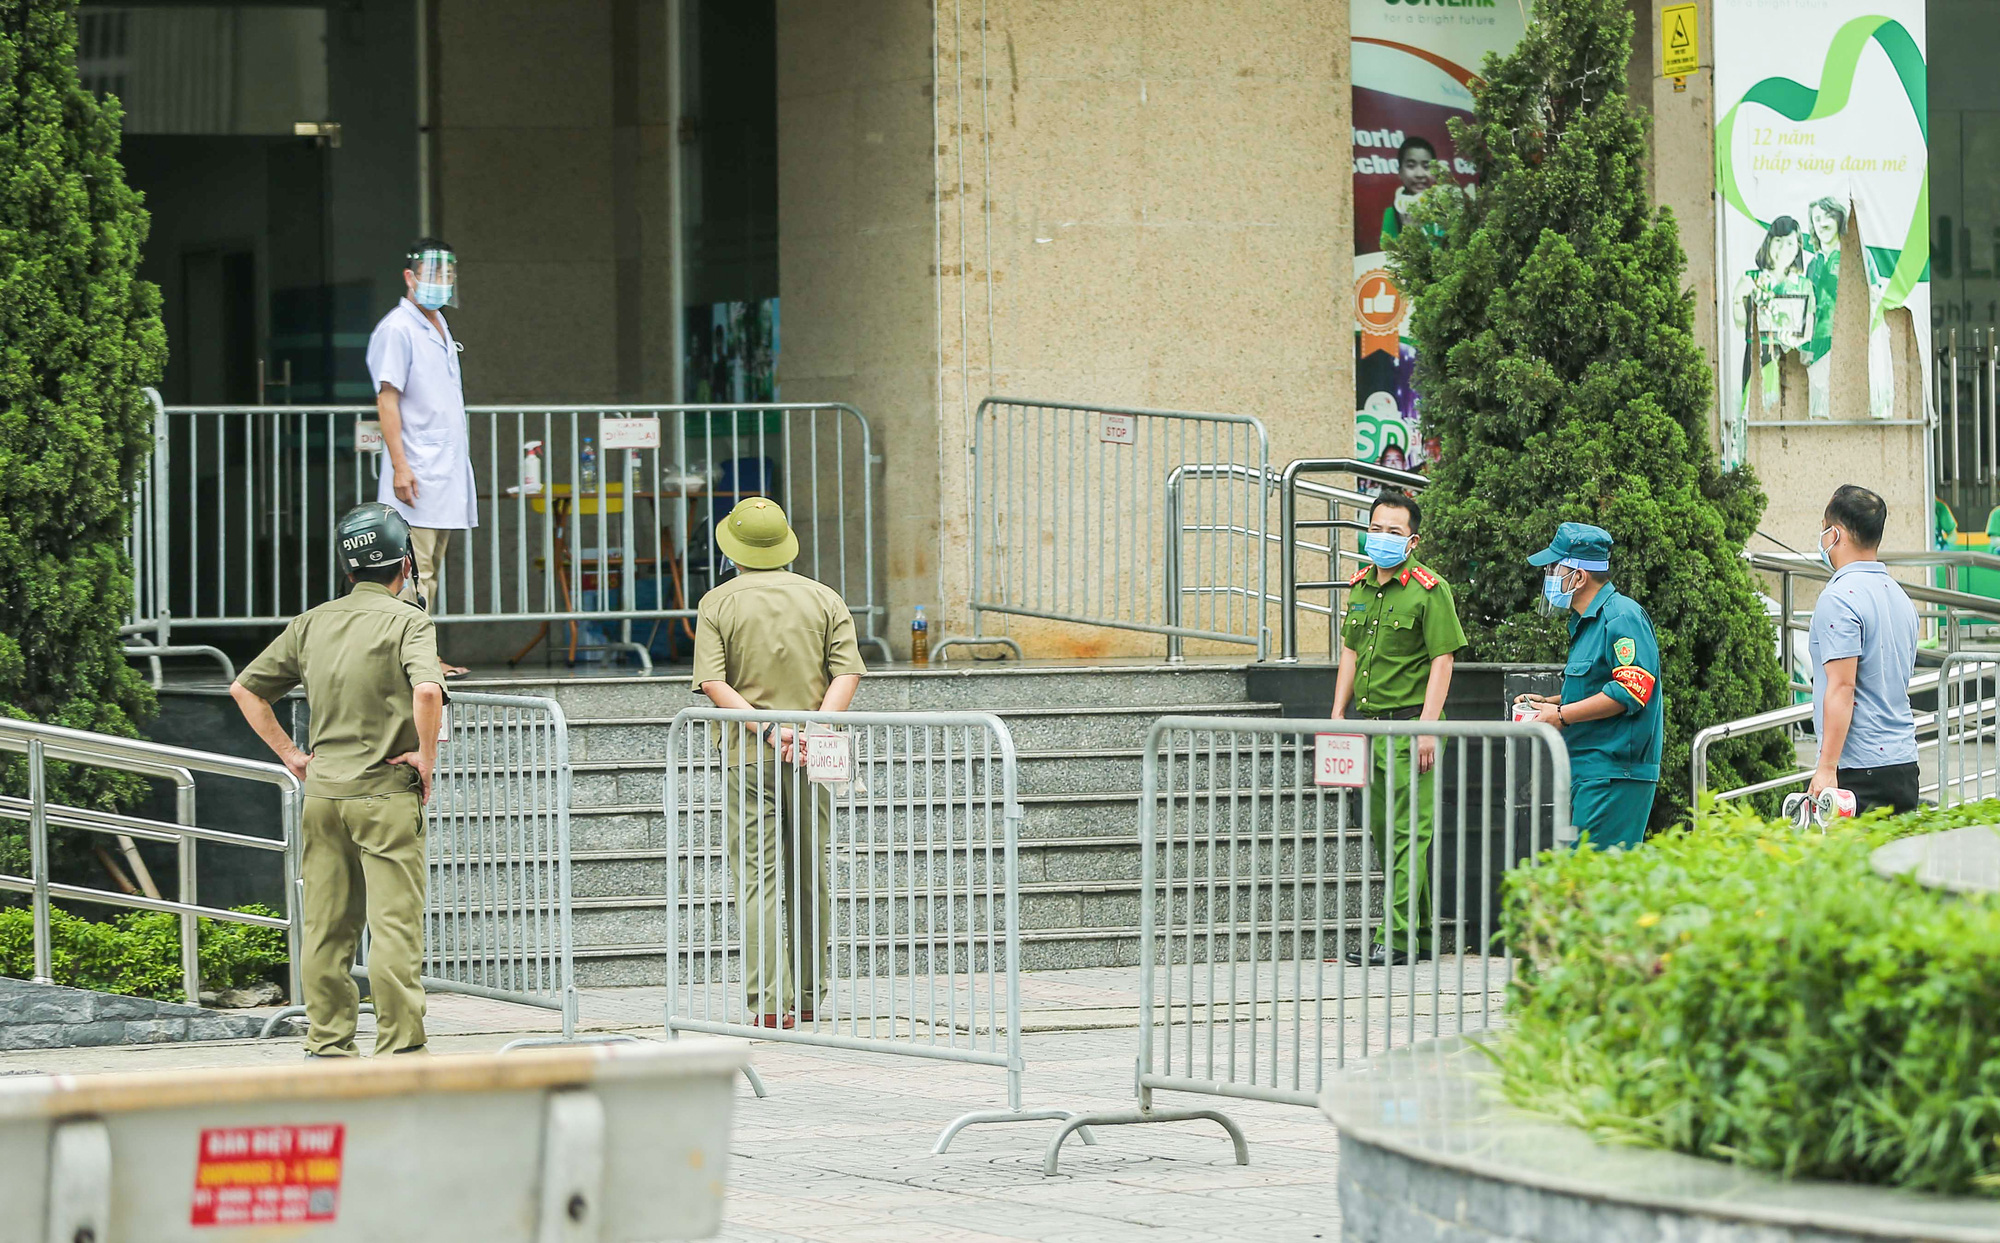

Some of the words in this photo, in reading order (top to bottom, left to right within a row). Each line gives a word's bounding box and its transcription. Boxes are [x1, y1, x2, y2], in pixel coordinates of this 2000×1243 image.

[1418, 14, 1455, 25] bright
[1460, 14, 1495, 25] future
[1352, 127, 1405, 148] orld
[1752, 128, 1772, 146] 12
[1777, 129, 1815, 146] năm
[1796, 154, 1835, 175] sáng
[1840, 155, 1877, 171] đam
[1882, 155, 1908, 172] mê
[1106, 426, 1127, 438] STOP
[1328, 740, 1350, 750] POLICE
[1324, 757, 1354, 774] STOP
